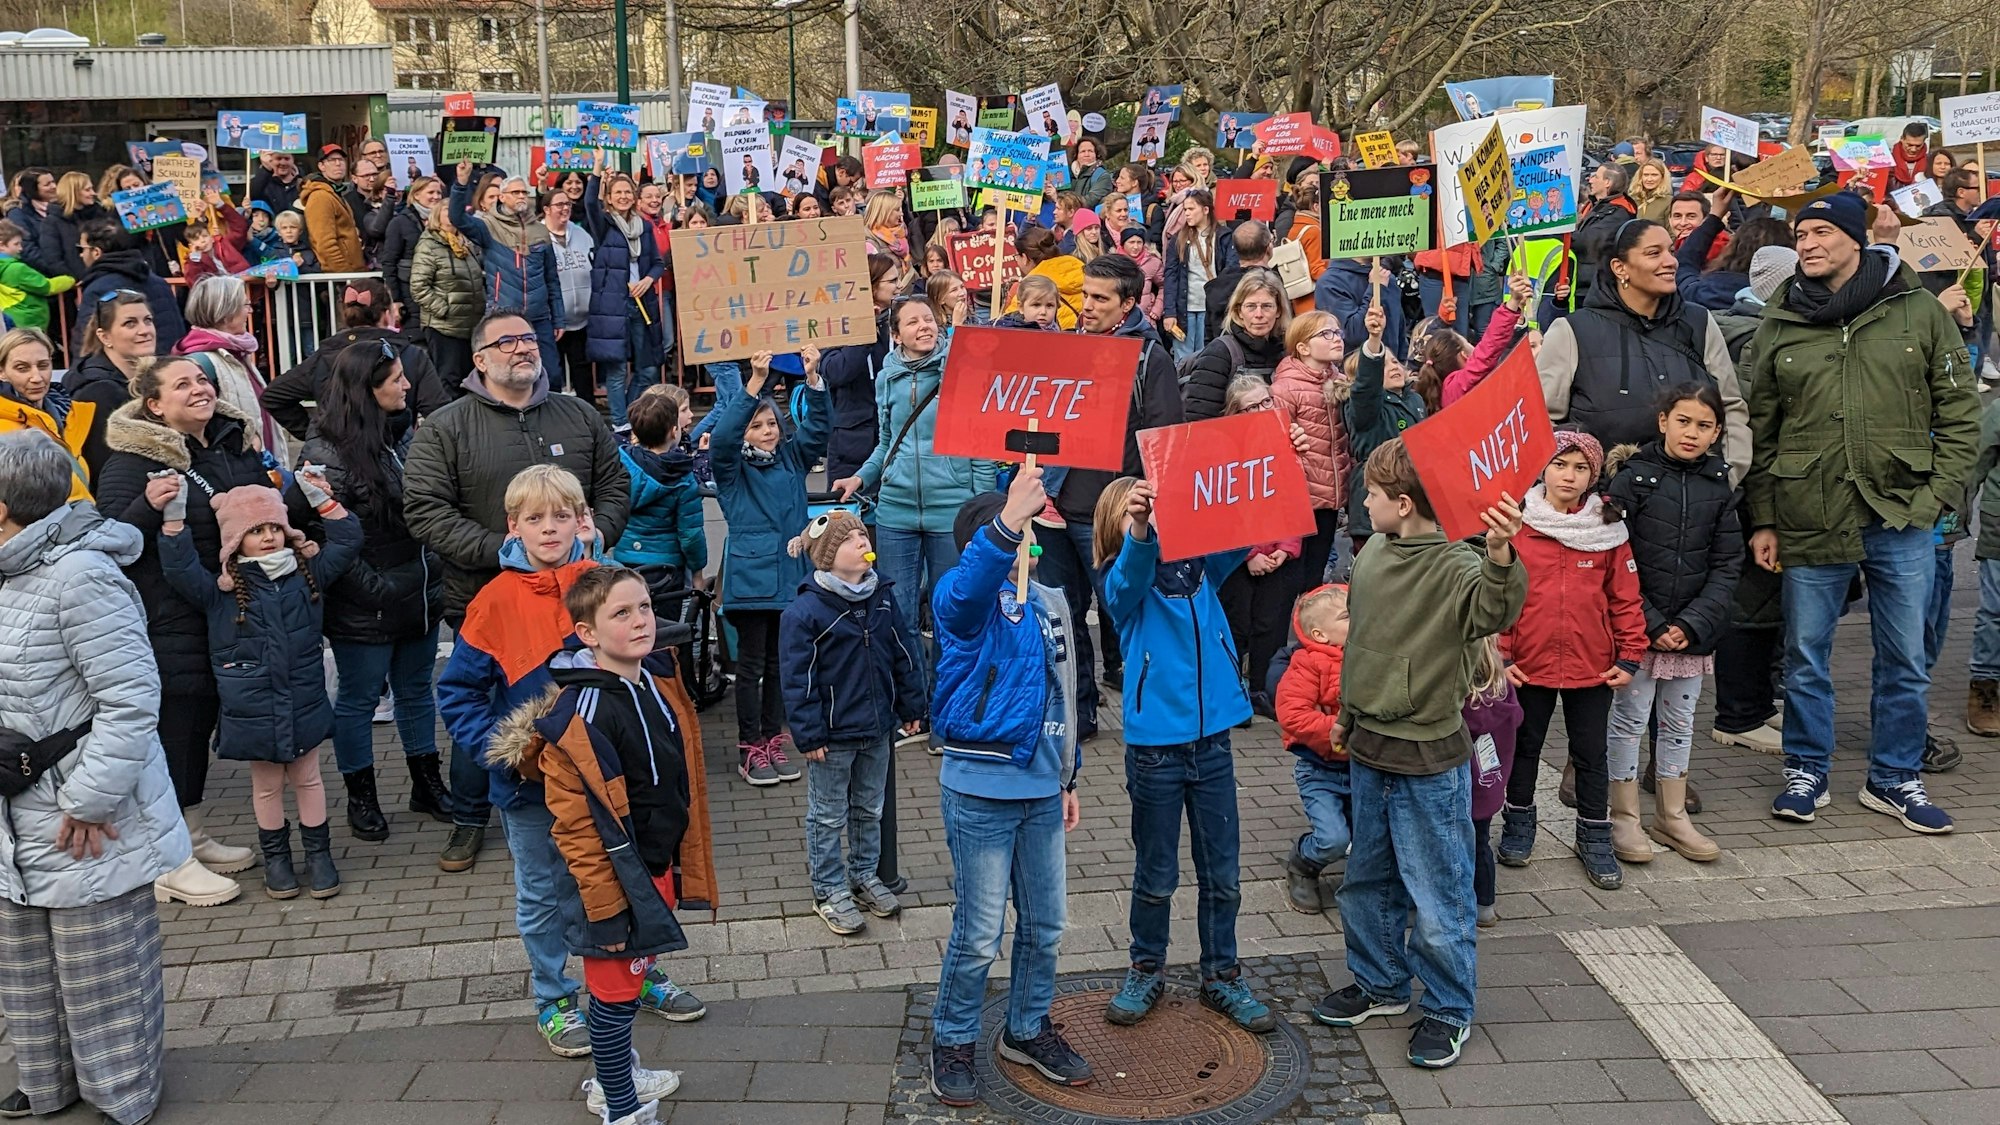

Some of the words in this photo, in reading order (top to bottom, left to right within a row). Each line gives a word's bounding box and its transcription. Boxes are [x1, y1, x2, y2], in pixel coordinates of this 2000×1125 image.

[448, 100, 470, 110] NIETE
[1980, 104, 2000, 113] WEG
[1951, 116, 2000, 128] KLIMASCHUT
[724, 129, 751, 137] BILDUNG
[1013, 136, 1042, 147] KINDER
[1264, 145, 1304, 153] BESTIMMT
[1008, 148, 1042, 160] SCHULEN
[1464, 162, 1476, 182] DU
[1476, 128, 1500, 170] KOMMST
[1520, 151, 1555, 167] KINDER
[157, 169, 197, 179] SCHULEN
[1474, 175, 1490, 202] HIER
[1490, 153, 1504, 183] NICHT
[1518, 168, 1562, 187] SCHULEN
[916, 184, 925, 193] Ene
[941, 181, 954, 190] meck
[917, 197, 927, 208] und
[928, 197, 934, 206] du
[936, 196, 945, 206] bist
[1006, 194, 1023, 204] EIN!
[1228, 194, 1263, 207] NIETE
[1339, 202, 1358, 222] Ene
[1360, 206, 1387, 220] mene
[1389, 197, 1414, 218] meck
[696, 220, 828, 258] SCHLUSS
[1339, 231, 1360, 252] und
[1361, 231, 1374, 250] du
[1376, 230, 1395, 249] bist
[1397, 226, 1419, 252] weg!
[1904, 232, 1952, 248] Keine
[691, 256, 760, 289] MIT
[787, 247, 848, 277] DER
[693, 281, 869, 321] SCHULPLATZ-
[694, 316, 850, 354] LOTTERIE
[980, 374, 1093, 420] NIETE
[1469, 397, 1529, 491] NIETE
[1193, 455, 1276, 511] NIETE
